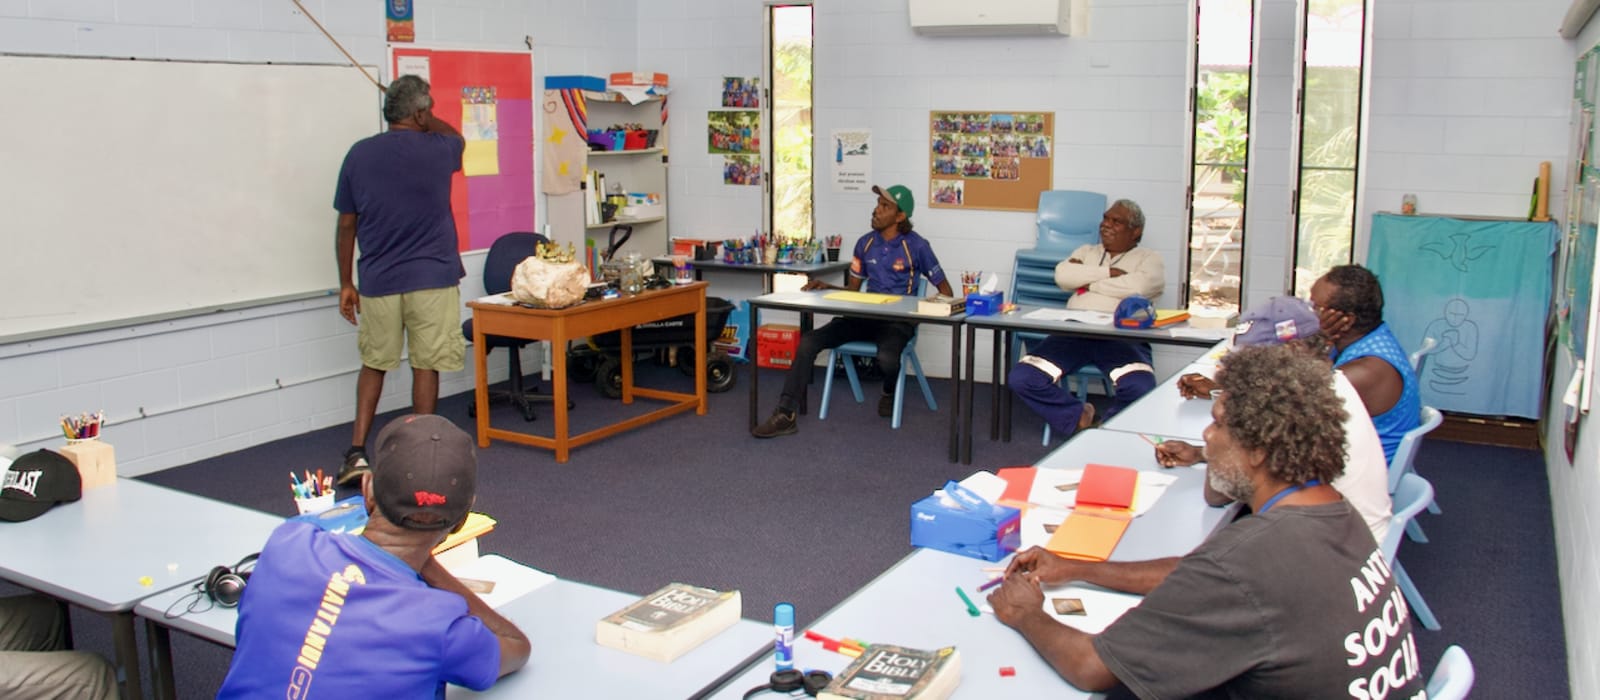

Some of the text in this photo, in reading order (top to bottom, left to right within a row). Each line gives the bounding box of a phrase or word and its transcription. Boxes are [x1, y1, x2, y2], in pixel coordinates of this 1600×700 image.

[649, 596, 697, 614] BIBLE
[666, 588, 712, 606] HOLY
[876, 650, 930, 669] HOLY
[864, 660, 920, 679] BIBLE
